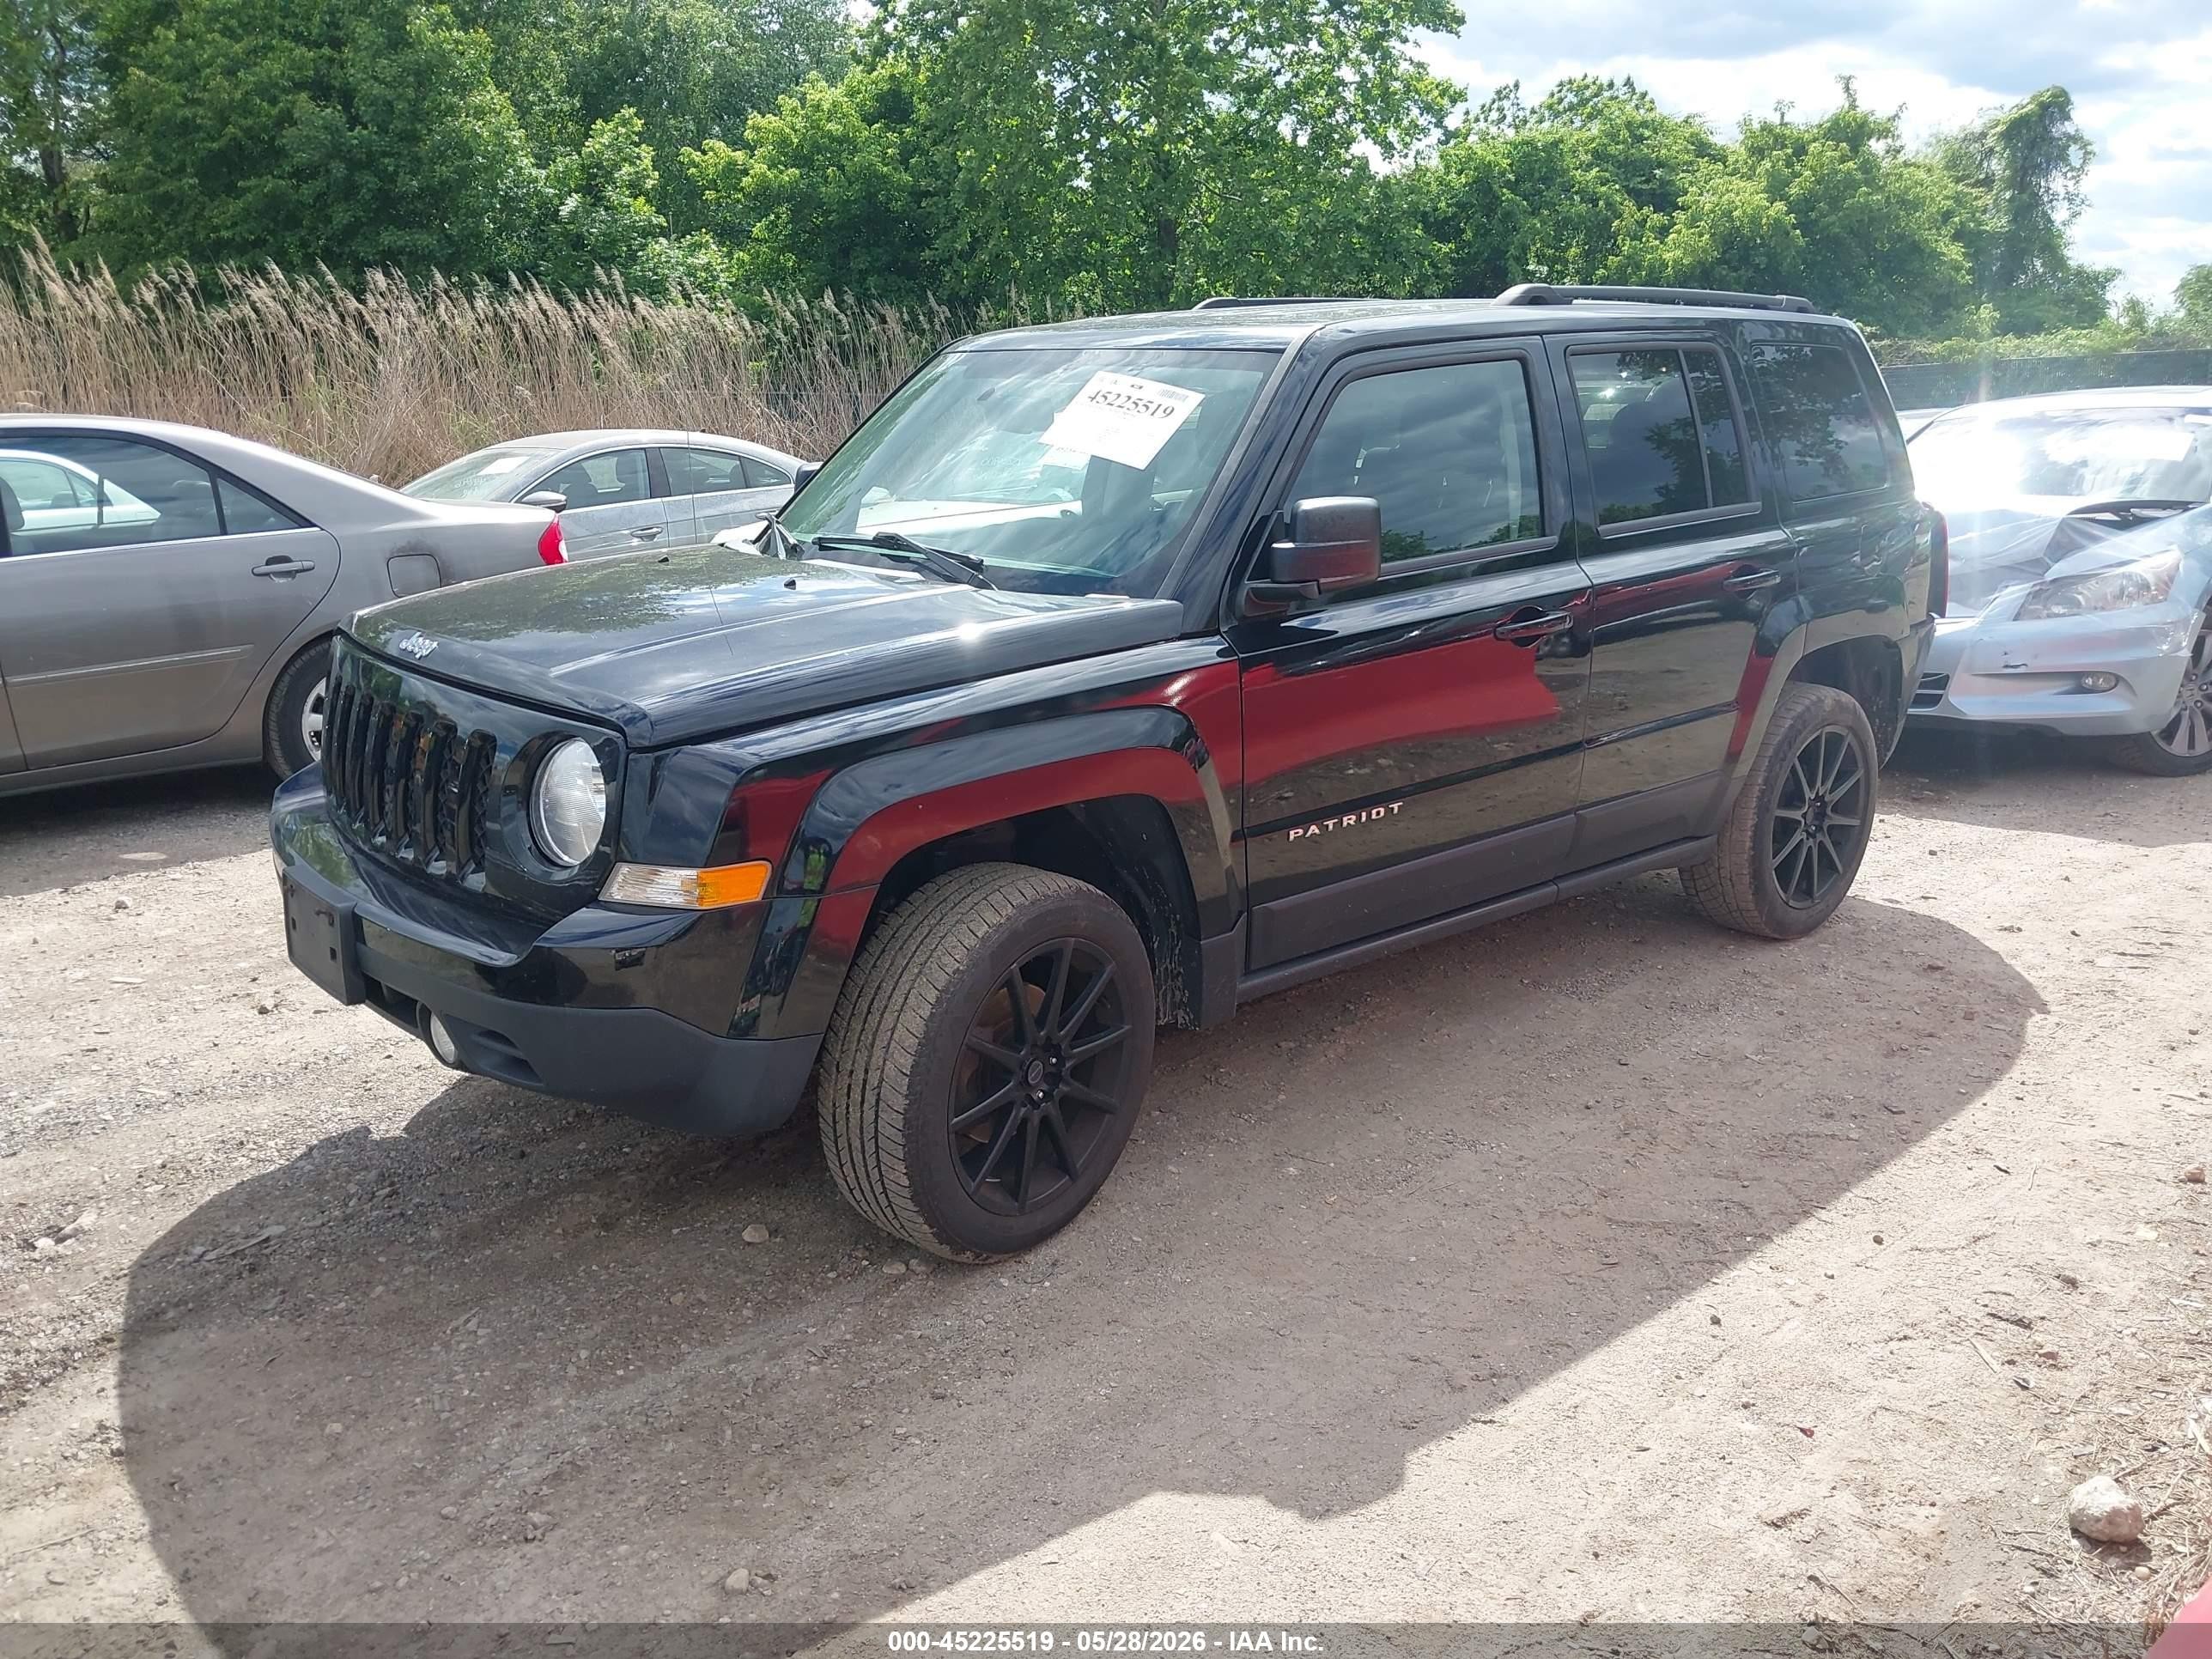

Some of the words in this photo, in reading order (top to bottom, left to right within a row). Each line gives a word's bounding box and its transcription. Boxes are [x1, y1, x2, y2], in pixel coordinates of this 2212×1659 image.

[1087, 389, 1176, 419] 45225519
[398, 631, 439, 659] Jeep
[1288, 802, 1404, 842] PATRIOT
